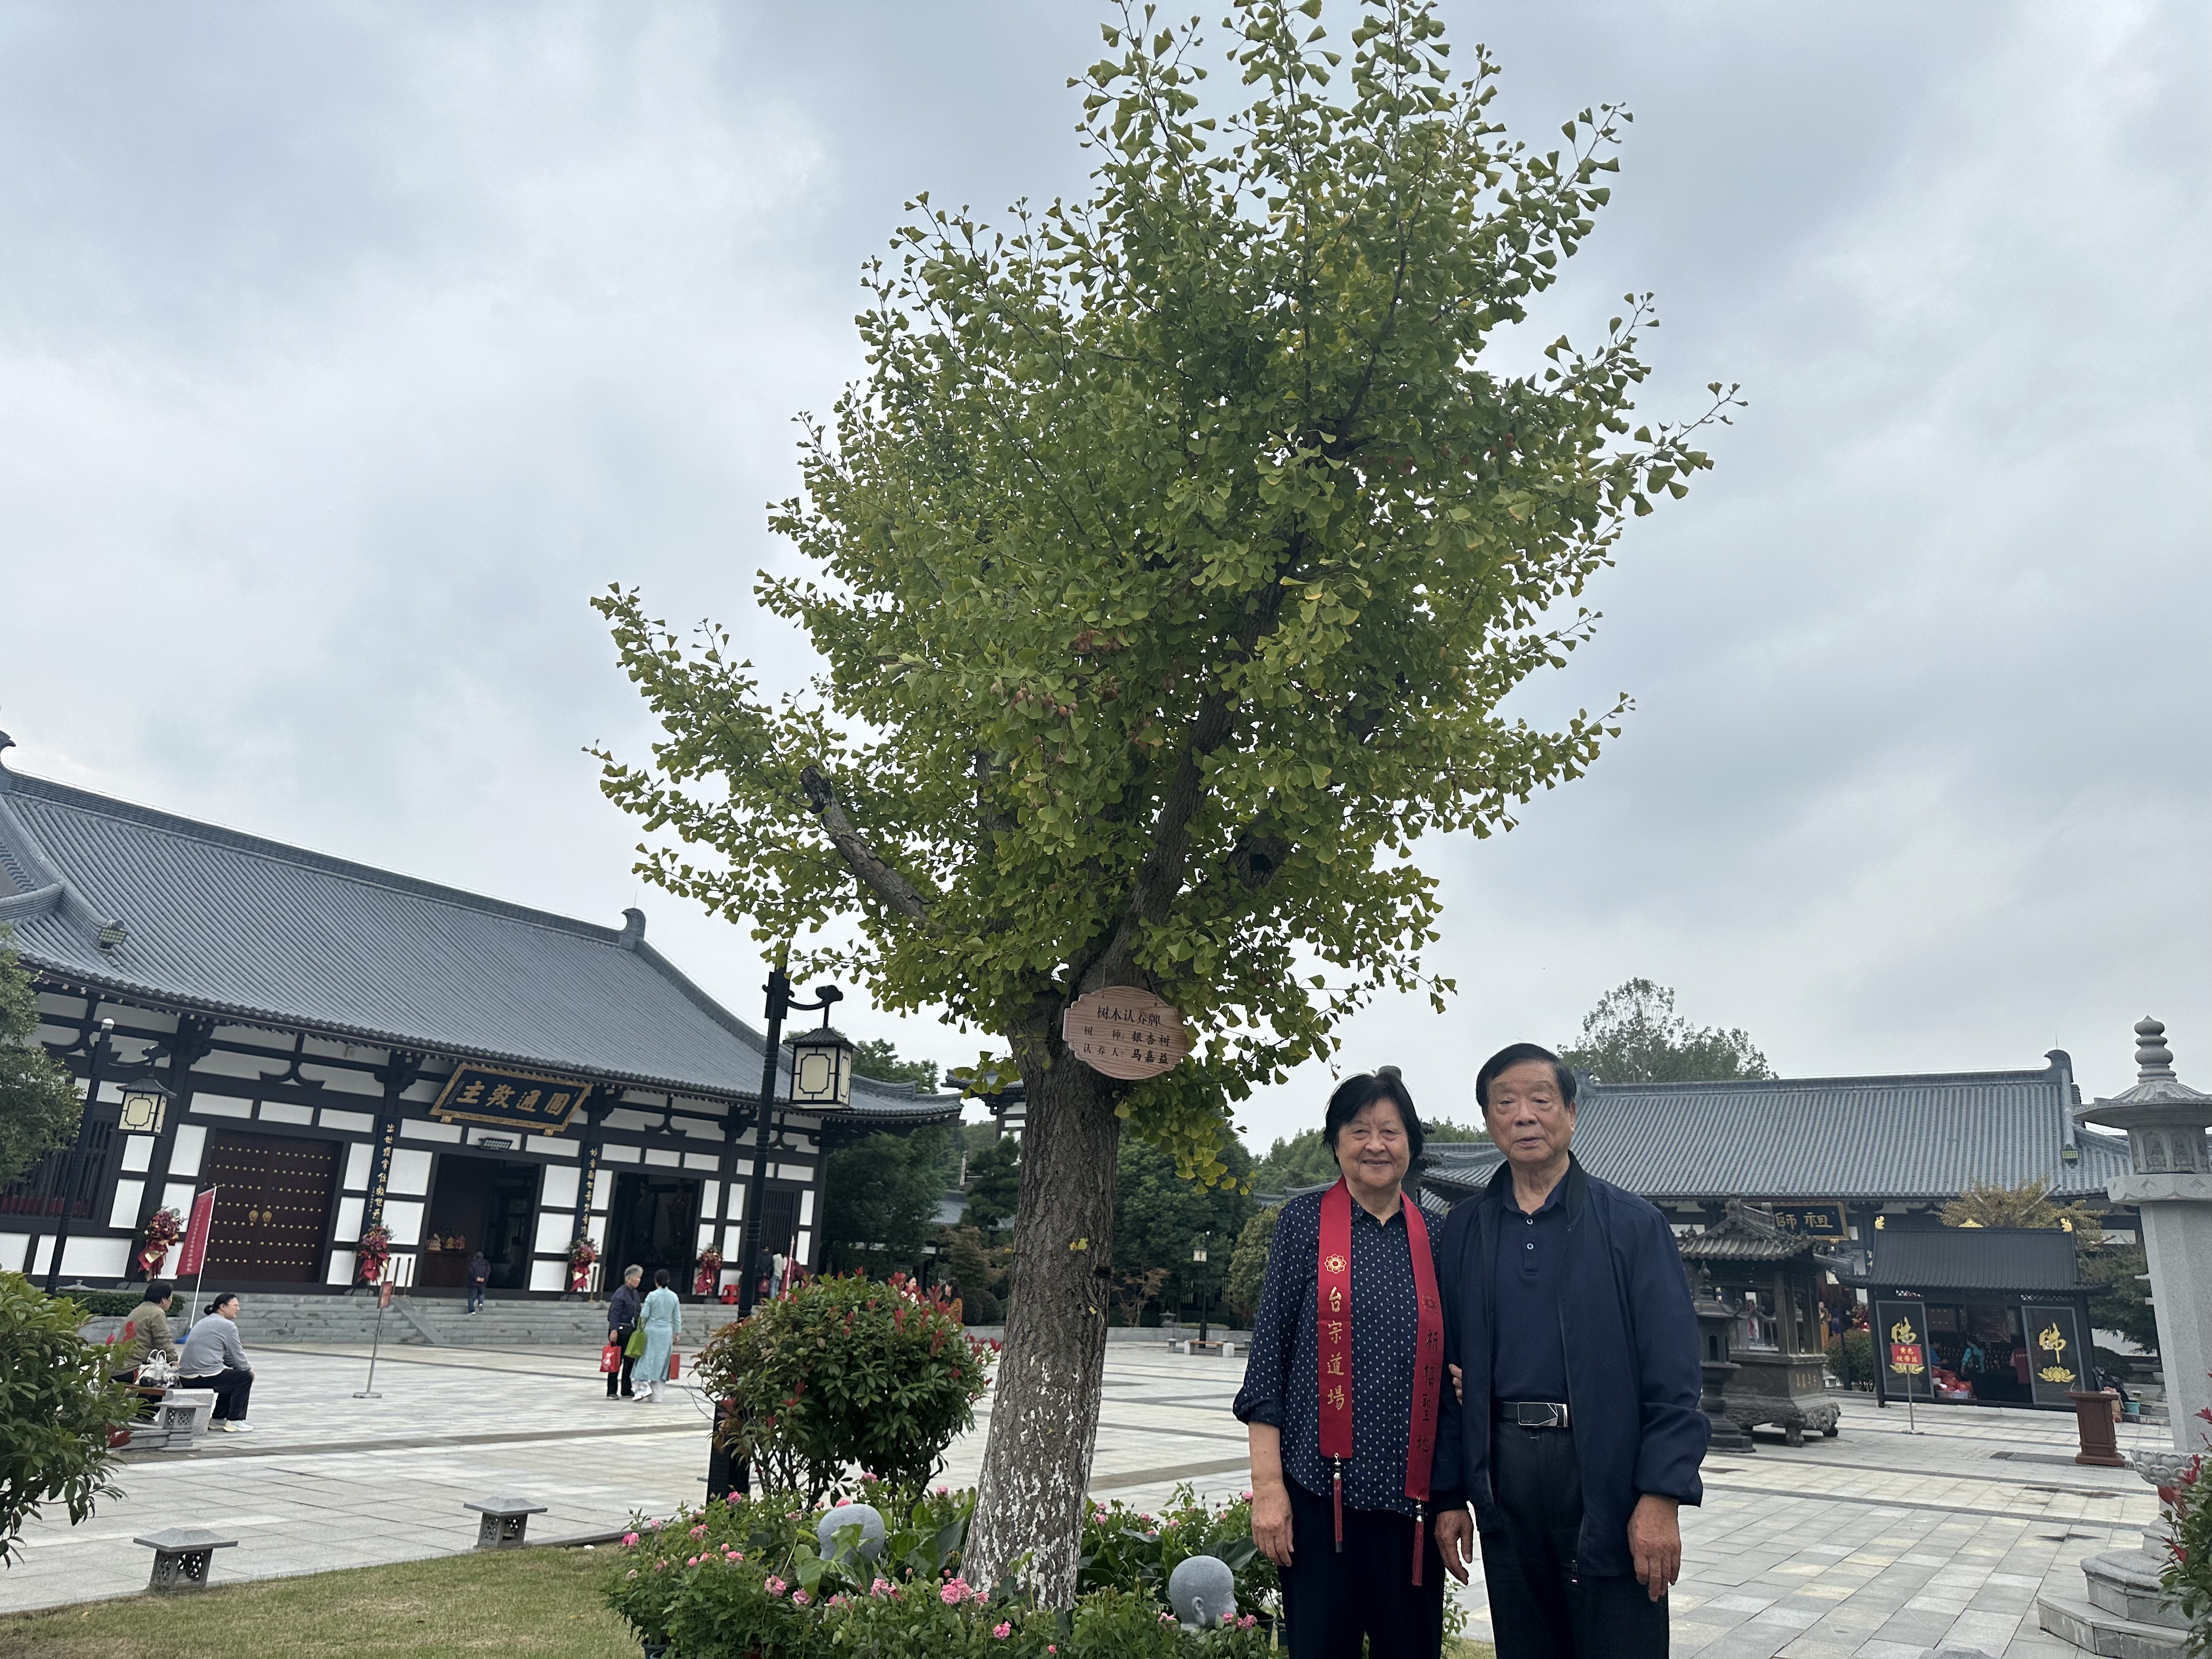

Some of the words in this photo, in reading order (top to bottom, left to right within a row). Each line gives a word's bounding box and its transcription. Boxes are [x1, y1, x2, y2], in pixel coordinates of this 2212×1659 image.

[1097, 1005, 1161, 1027] 树木认养牌
[1132, 1030, 1170, 1047] 银杏树
[1131, 1048, 1169, 1064] 马嘉益
[1327, 1286, 1345, 1410] 台宗道場
[1899, 1346, 1914, 1355] 黄色
[2039, 1321, 2067, 1364] 佛
